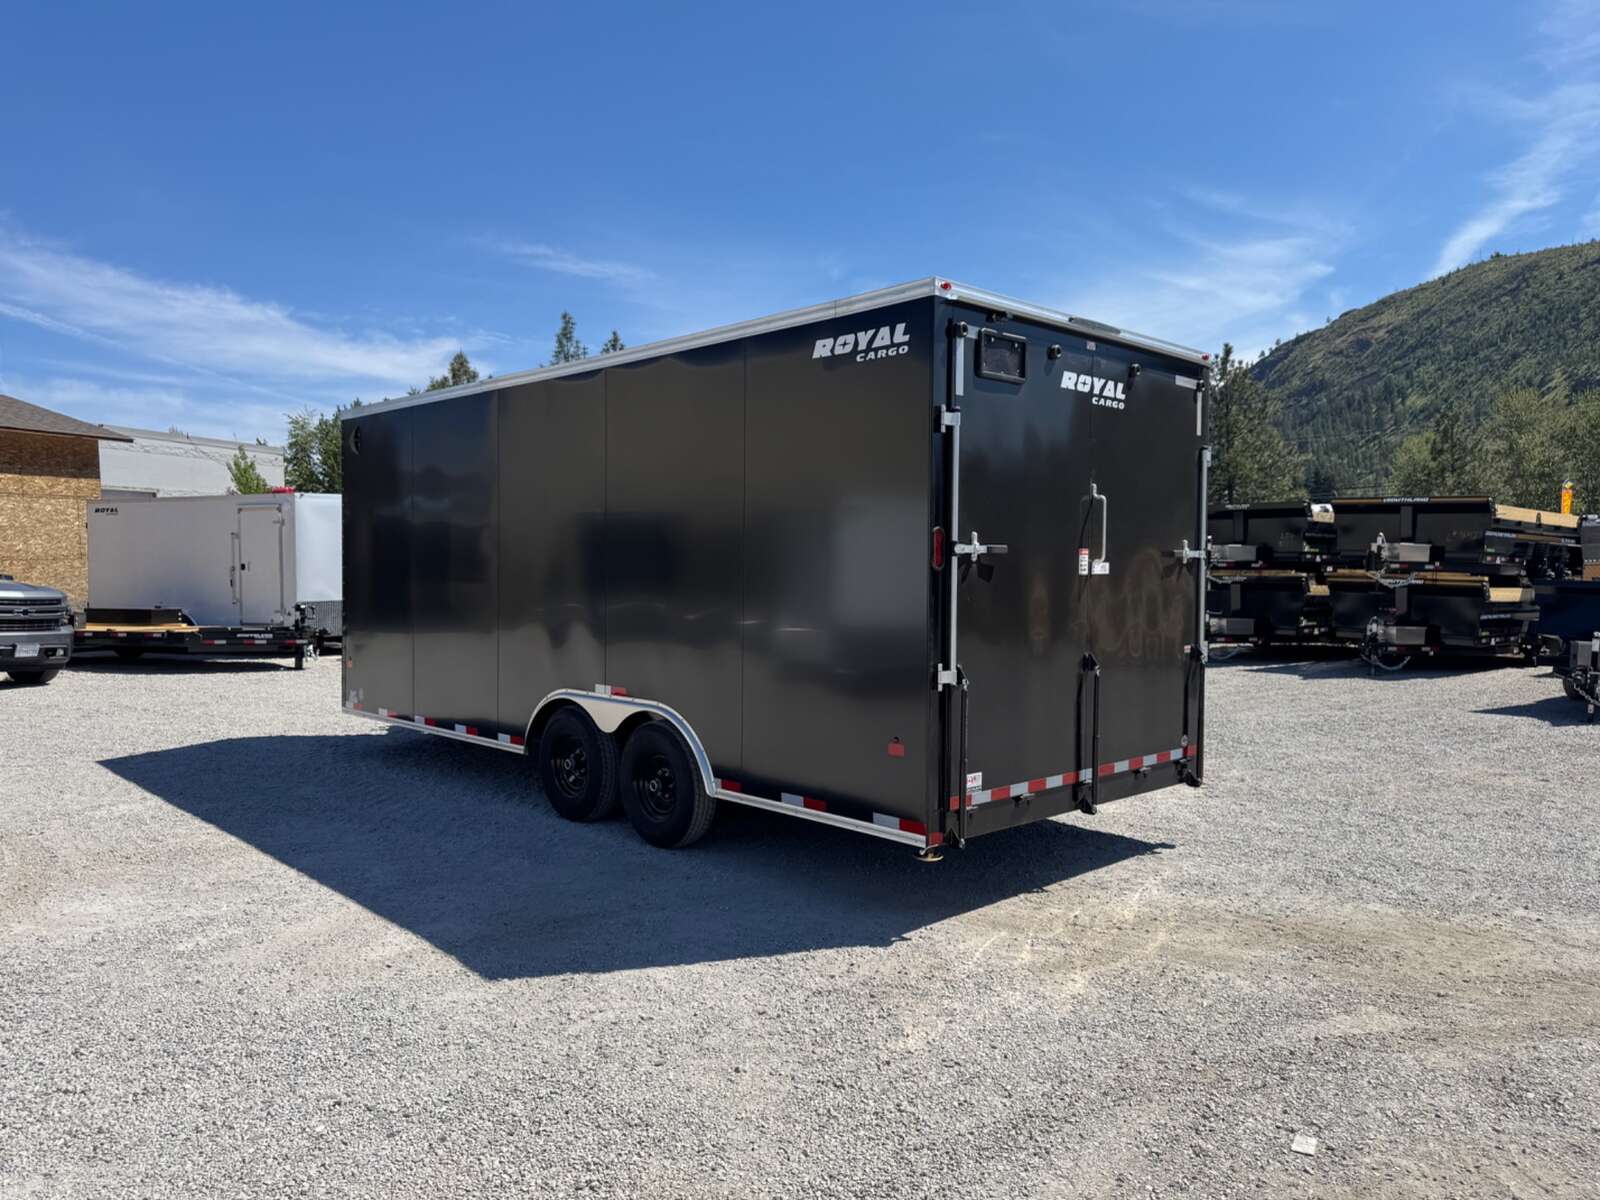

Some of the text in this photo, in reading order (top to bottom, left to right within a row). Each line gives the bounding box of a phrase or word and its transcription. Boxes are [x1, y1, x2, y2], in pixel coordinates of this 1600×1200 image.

[812, 323, 910, 359] ROYAL
[856, 345, 908, 362] CARGO
[1061, 370, 1126, 400] ROYAL
[1092, 396, 1125, 410] CARGO
